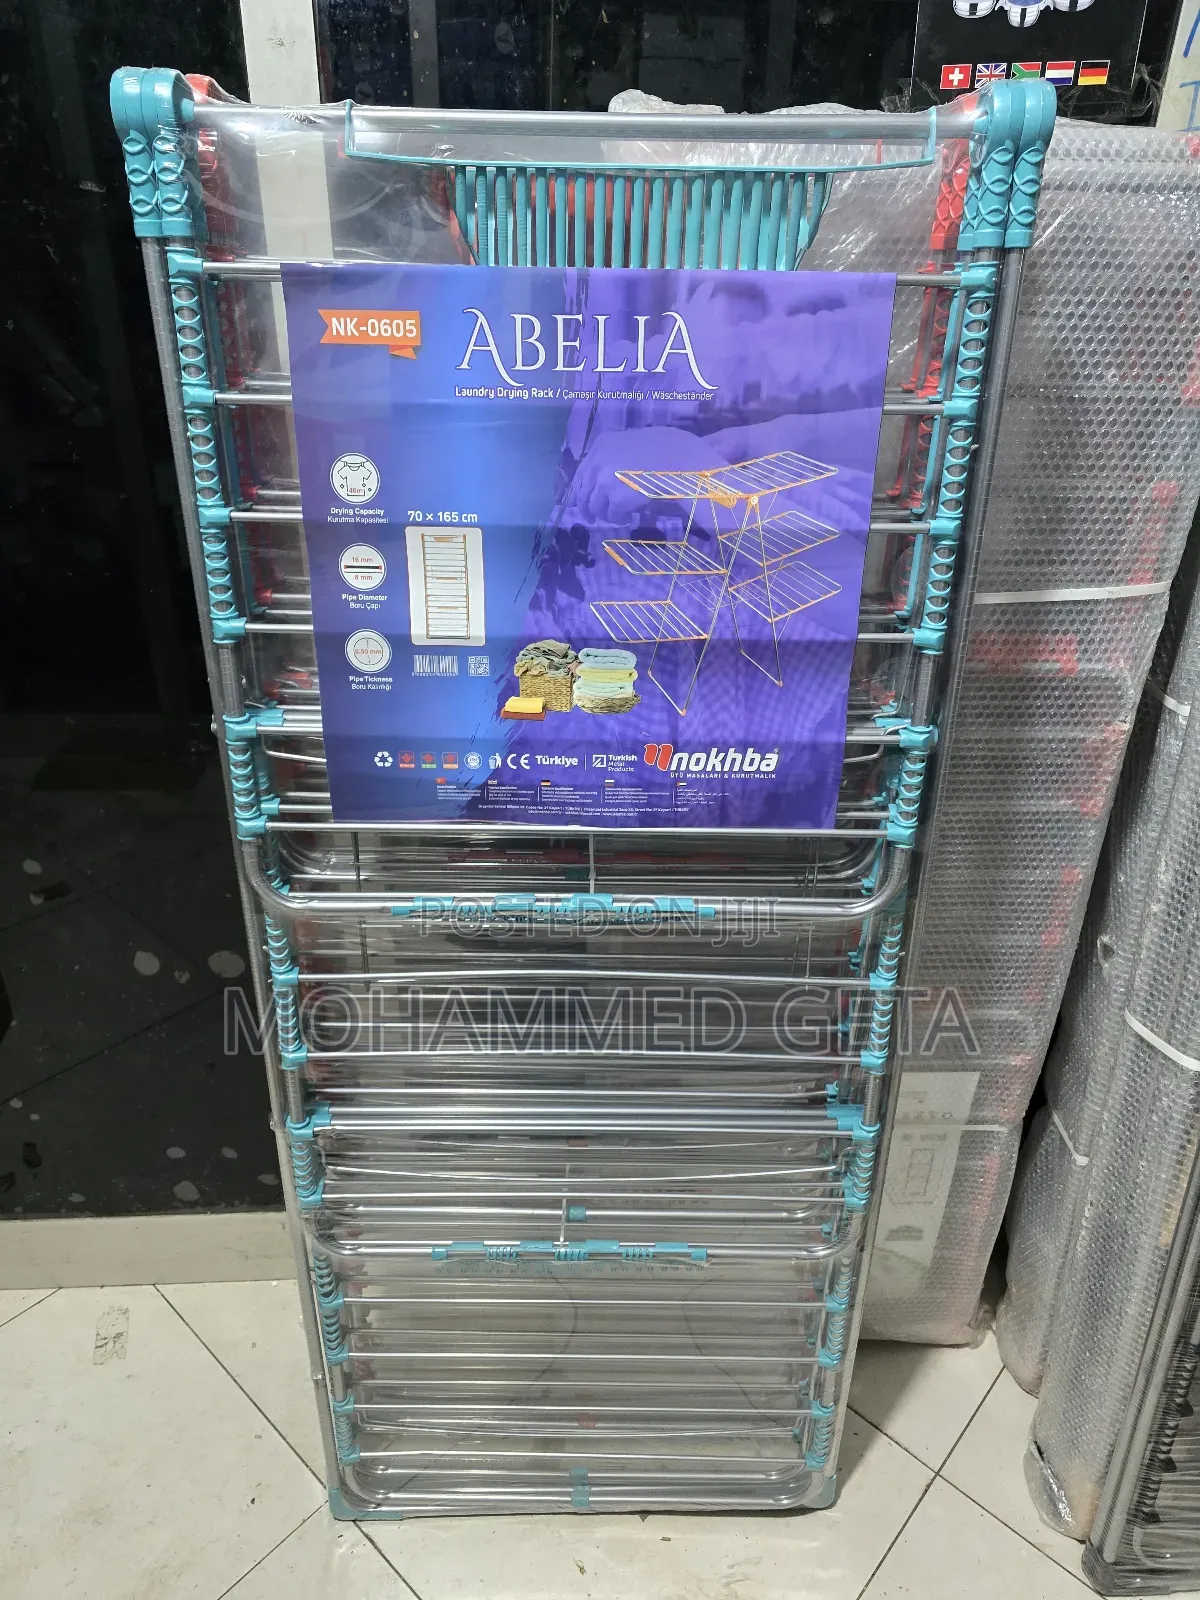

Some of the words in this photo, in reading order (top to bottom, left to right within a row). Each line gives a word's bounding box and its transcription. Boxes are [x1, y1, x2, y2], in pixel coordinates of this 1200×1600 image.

[331, 317, 417, 338] NK-0605
[455, 307, 719, 390] ABELIA
[455, 386, 494, 399] Laundry
[497, 387, 529, 400] Drying
[531, 388, 553, 398] Rack
[555, 388, 561, 398] /
[562, 390, 595, 400] Çamaşır
[597, 390, 644, 401] Kurutmalığı
[651, 390, 714, 401] Wäscheständer
[330, 507, 353, 516] Drying
[354, 508, 385, 517] Capacity
[407, 510, 423, 522] 70
[437, 511, 459, 523] 165
[461, 513, 478, 522] cm
[355, 517, 389, 525] Kapasitesi
[341, 593, 357, 602] Pipe
[365, 602, 381, 611] Çapı
[348, 675, 364, 683] Pipe
[364, 675, 393, 683] Tickness
[534, 755, 579, 768] Türkiye
[607, 754, 638, 762] Turkish
[670, 747, 779, 772] nokhba
